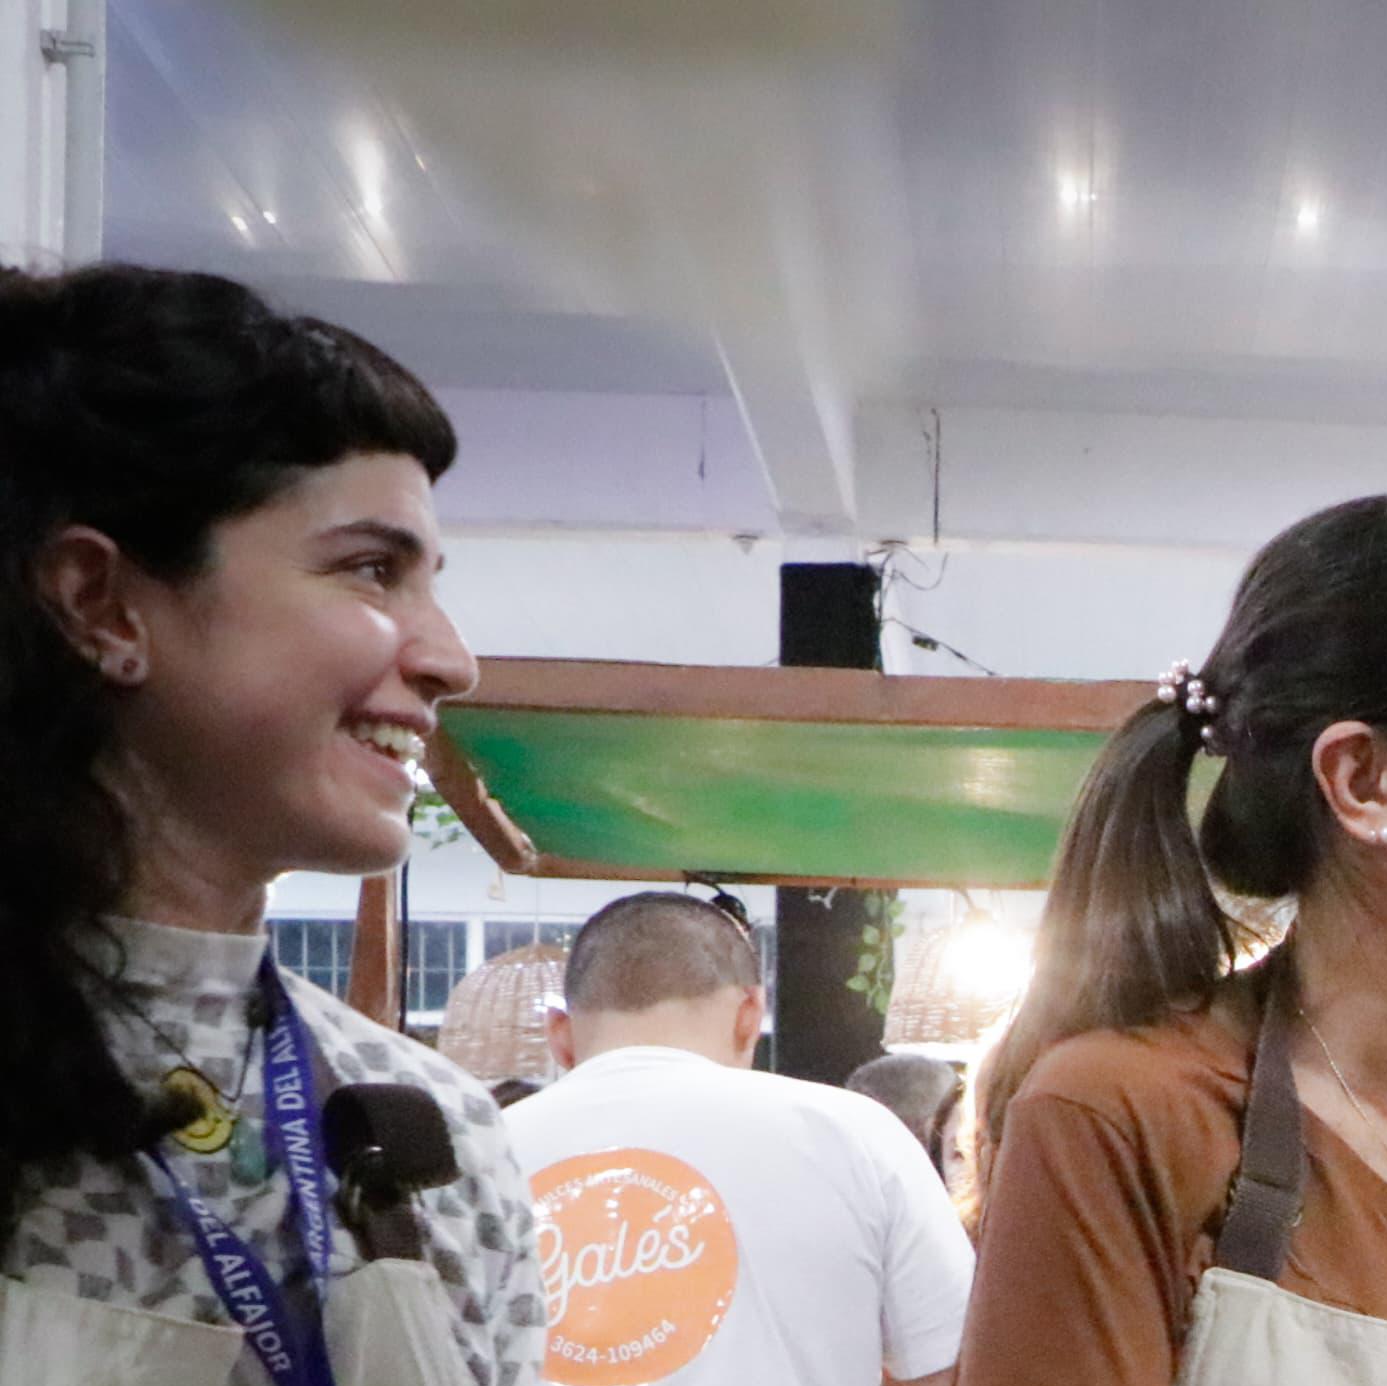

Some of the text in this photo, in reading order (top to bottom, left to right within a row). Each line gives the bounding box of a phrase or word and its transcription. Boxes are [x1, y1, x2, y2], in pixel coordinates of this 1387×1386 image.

[273, 1066, 306, 1111] DEL
[188, 1198, 293, 1373] DEL ALFAJOR
[550, 1318, 677, 1364] 3624-109464
